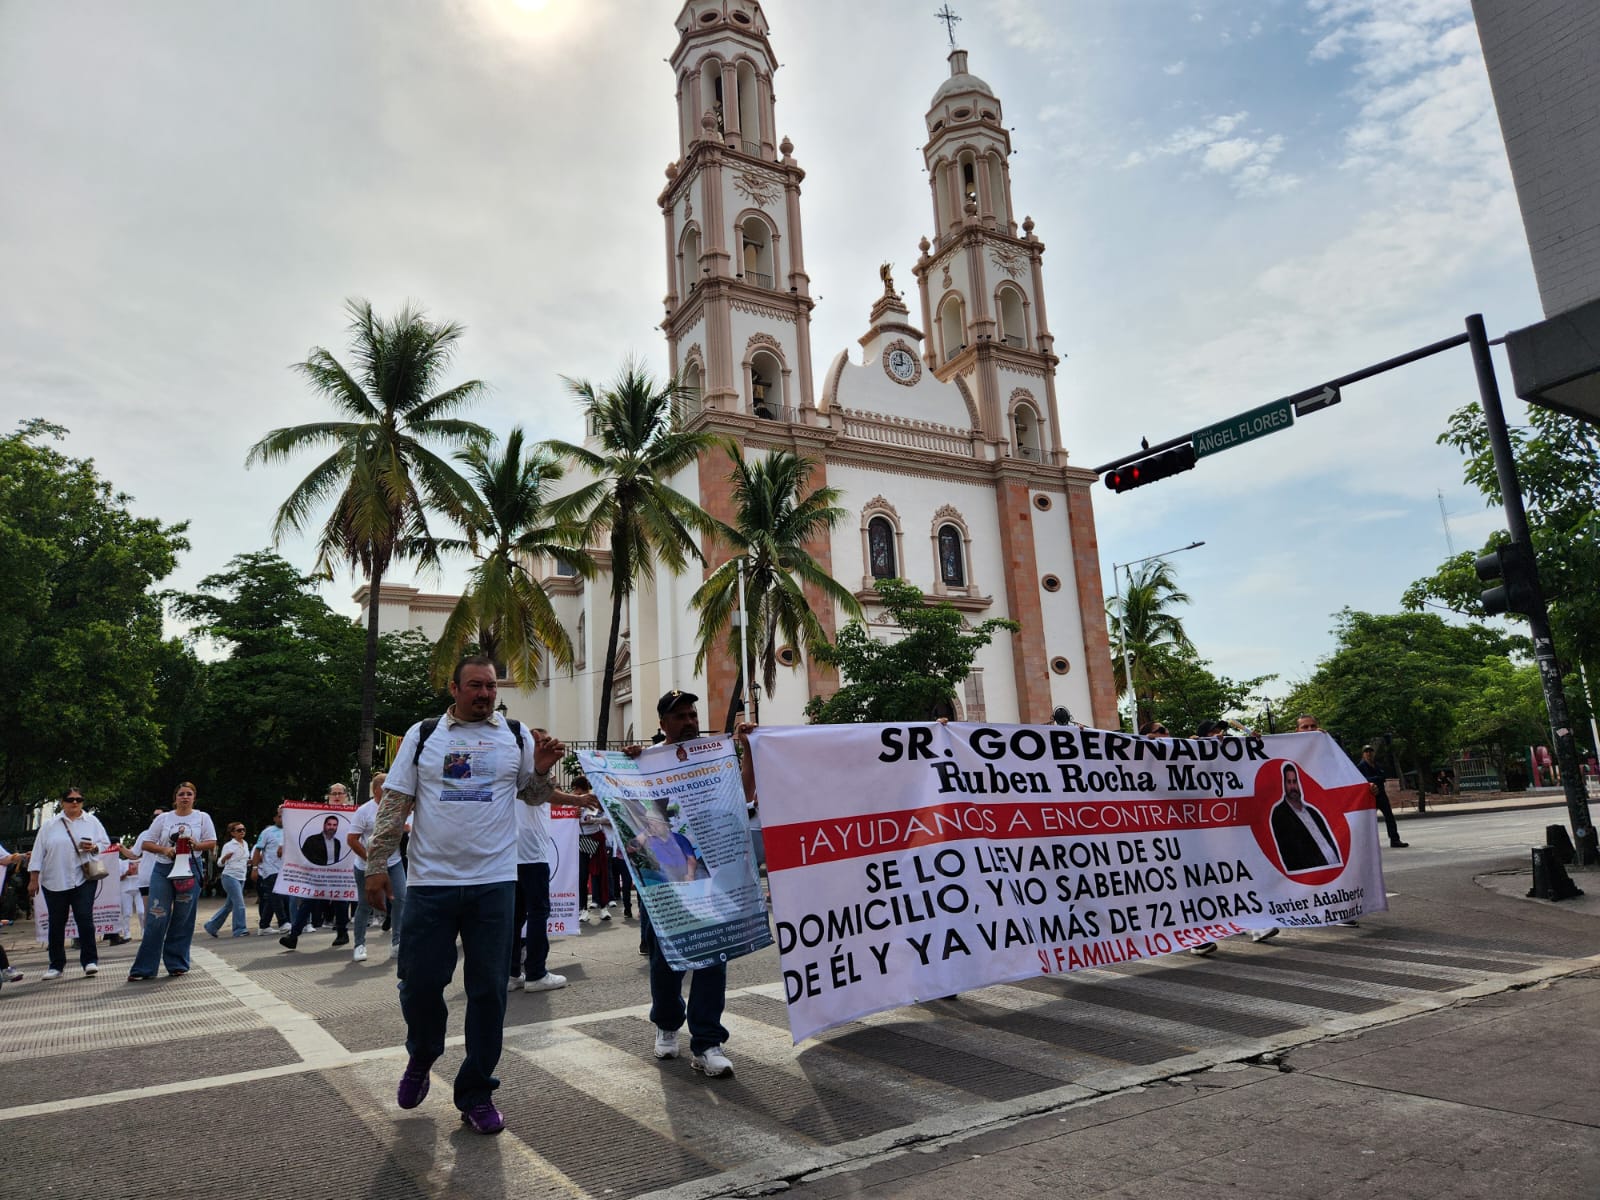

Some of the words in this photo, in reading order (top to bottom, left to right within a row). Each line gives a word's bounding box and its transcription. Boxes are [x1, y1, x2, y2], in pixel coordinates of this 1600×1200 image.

[1198, 427, 1238, 454] ANGEL
[1239, 408, 1288, 438] FLORES
[688, 741, 723, 753] SINALOA
[878, 726, 954, 763] SR.
[968, 727, 1271, 763] GOBERNADOR
[660, 784, 687, 796] SAINZ
[687, 776, 722, 790] RODELO
[666, 765, 721, 783] encontrar
[725, 761, 734, 769] a
[930, 761, 1052, 794] Ruben
[1056, 763, 1157, 793] Rocha
[1165, 764, 1244, 798] Moya
[799, 807, 997, 865] ¡AYUDANOS
[1007, 808, 1032, 833] A
[1041, 801, 1238, 831] ENCONTRARLO!
[865, 859, 903, 894] SE
[912, 848, 966, 884] LO
[1116, 839, 1148, 865] DE
[1152, 836, 1182, 862] SU
[288, 885, 300, 894] 66
[302, 886, 311, 896] 71
[775, 883, 980, 956] DOMICILIO,
[985, 878, 1003, 907] Y
[1007, 877, 1048, 906] NO
[1055, 865, 1178, 903] SABEMOS
[1182, 859, 1254, 889] NADA
[1268, 896, 1310, 916] Javier
[1312, 886, 1365, 908] Adalberto
[547, 922, 553, 933] 2
[554, 921, 565, 932] 56
[783, 961, 822, 1006] DE
[829, 943, 862, 990] ÉL
[868, 941, 891, 975] Y
[905, 927, 972, 966] YA
[1039, 903, 1101, 944] MÁS
[1108, 905, 1142, 935] DE
[1145, 901, 1177, 929] 72
[1179, 890, 1264, 924] HORAS
[1053, 937, 1143, 972] FAMILIA
[1144, 932, 1173, 957] LO
[1173, 920, 1249, 949] ESPERA
